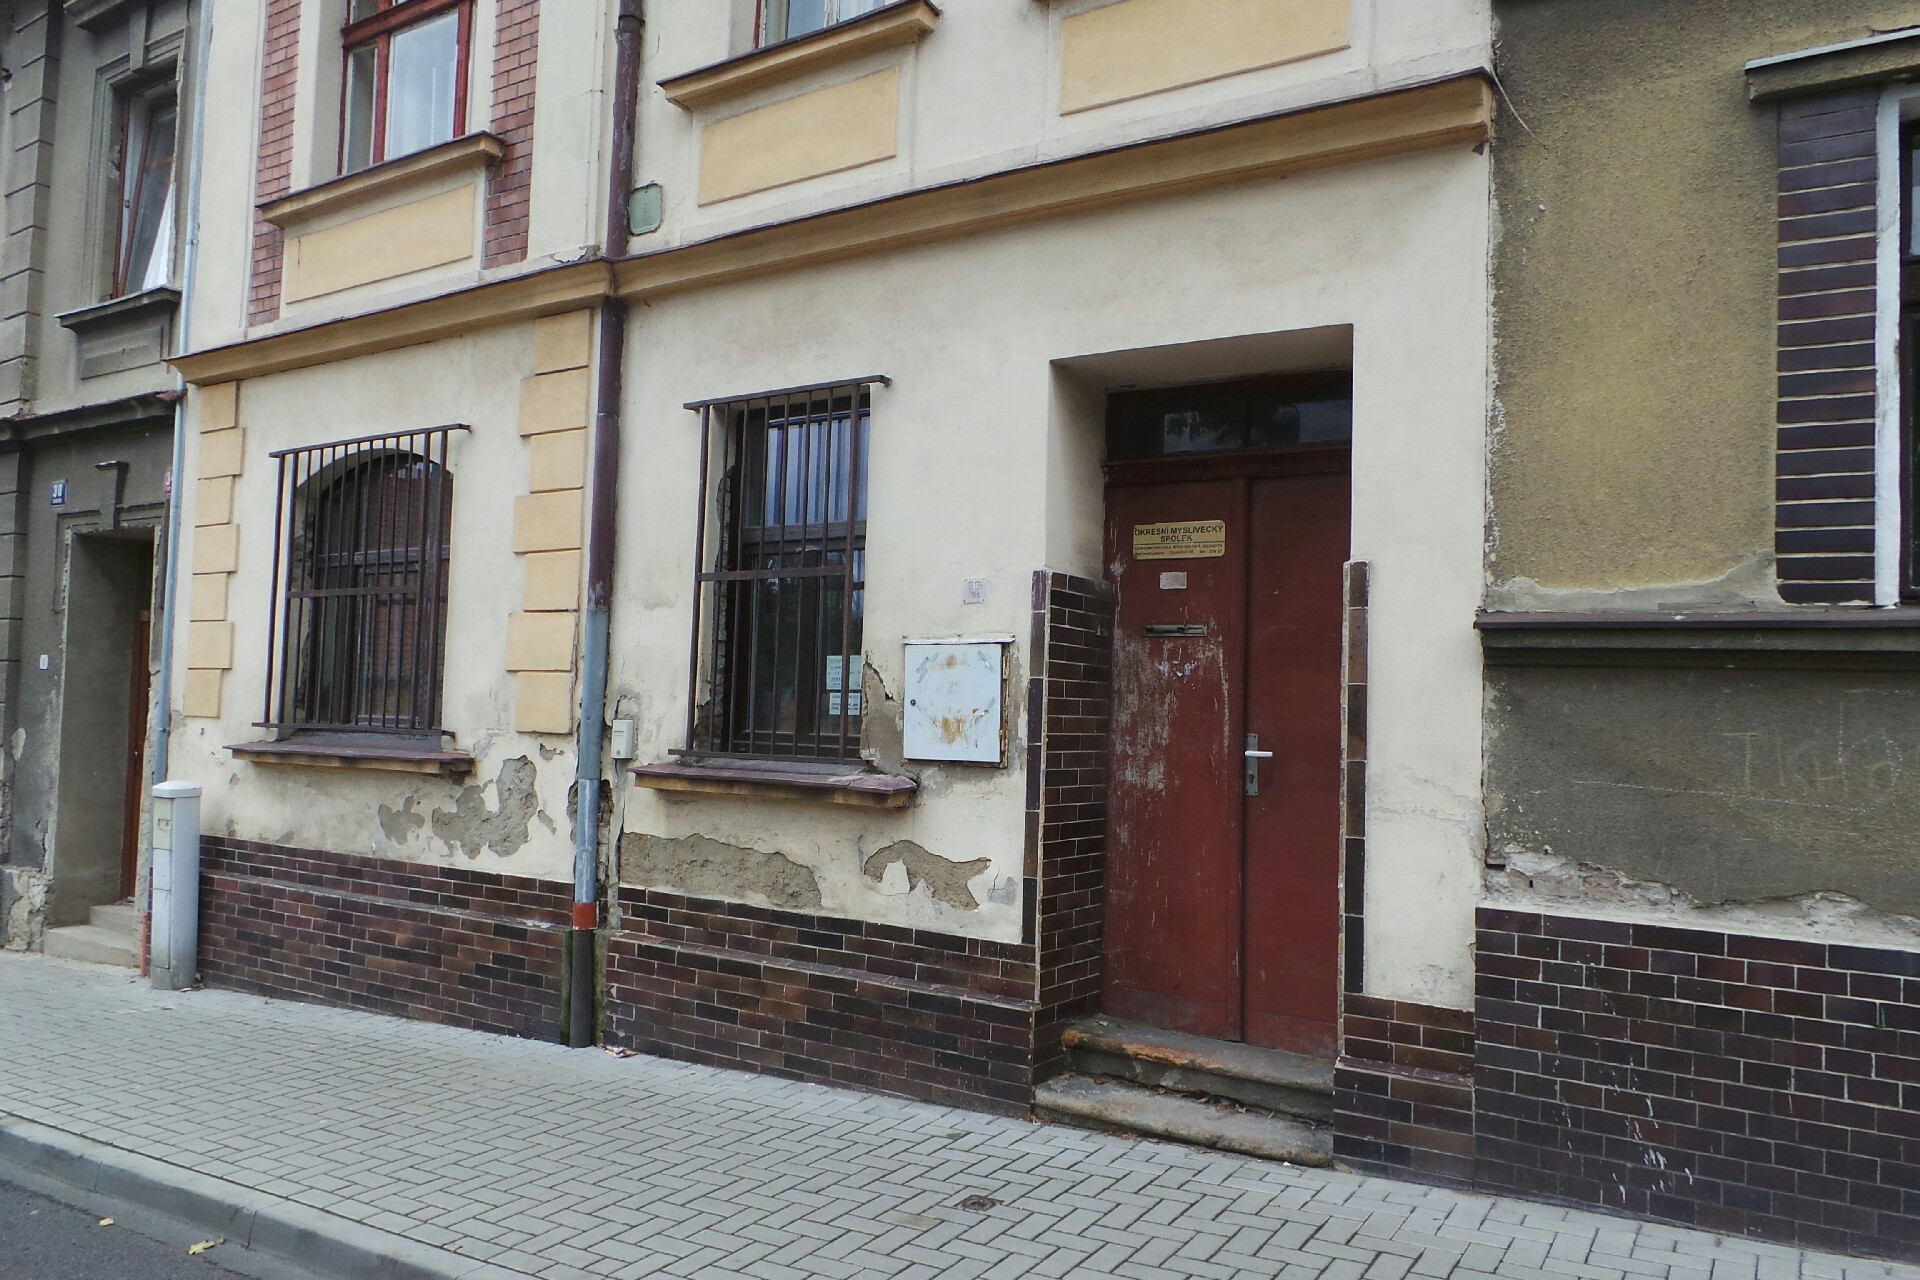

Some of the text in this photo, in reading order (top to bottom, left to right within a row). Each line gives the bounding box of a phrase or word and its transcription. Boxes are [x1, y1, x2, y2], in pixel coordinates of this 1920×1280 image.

[52, 484, 62, 498] 30
[1134, 524, 1223, 536] OKRESNÍ MYSLIVECKÝ
